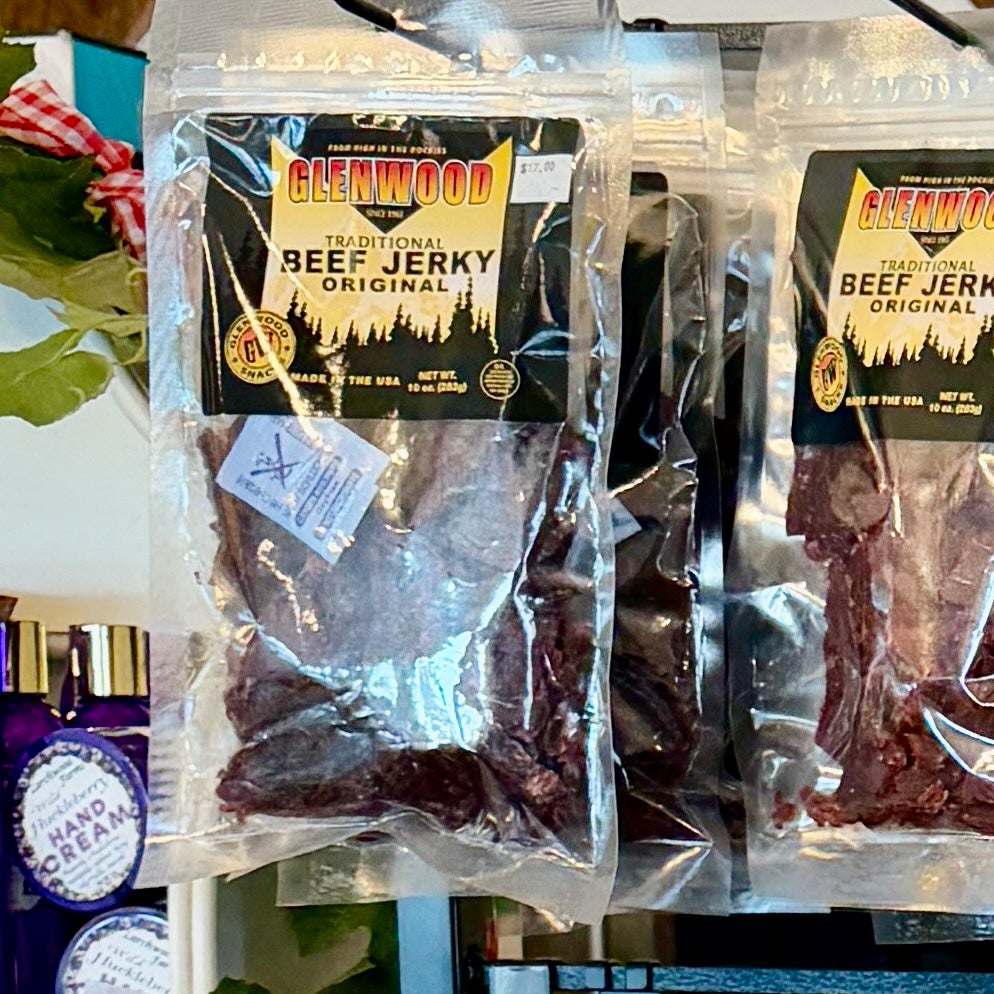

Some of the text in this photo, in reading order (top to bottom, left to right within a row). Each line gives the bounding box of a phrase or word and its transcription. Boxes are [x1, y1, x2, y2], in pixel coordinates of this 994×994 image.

[287, 157, 494, 206] GLENWOOD
[325, 235, 445, 250] TRADITIONAL
[281, 249, 495, 275] BEEF JERKY
[880, 260, 976, 273] TRADITIONAL
[322, 277, 449, 293] ORIGINAL
[840, 273, 912, 296] BEEF
[870, 300, 976, 314] ORIGINAL
[290, 372, 327, 384] MADE
[349, 375, 371, 385] THE
[376, 376, 400, 386] USA
[417, 371, 438, 381] NET
[408, 383, 419, 392] 10
[882, 395, 900, 406] THE
[903, 396, 924, 406] USA
[48, 799, 106, 848] HAND
[39, 803, 131, 874] CREAM
